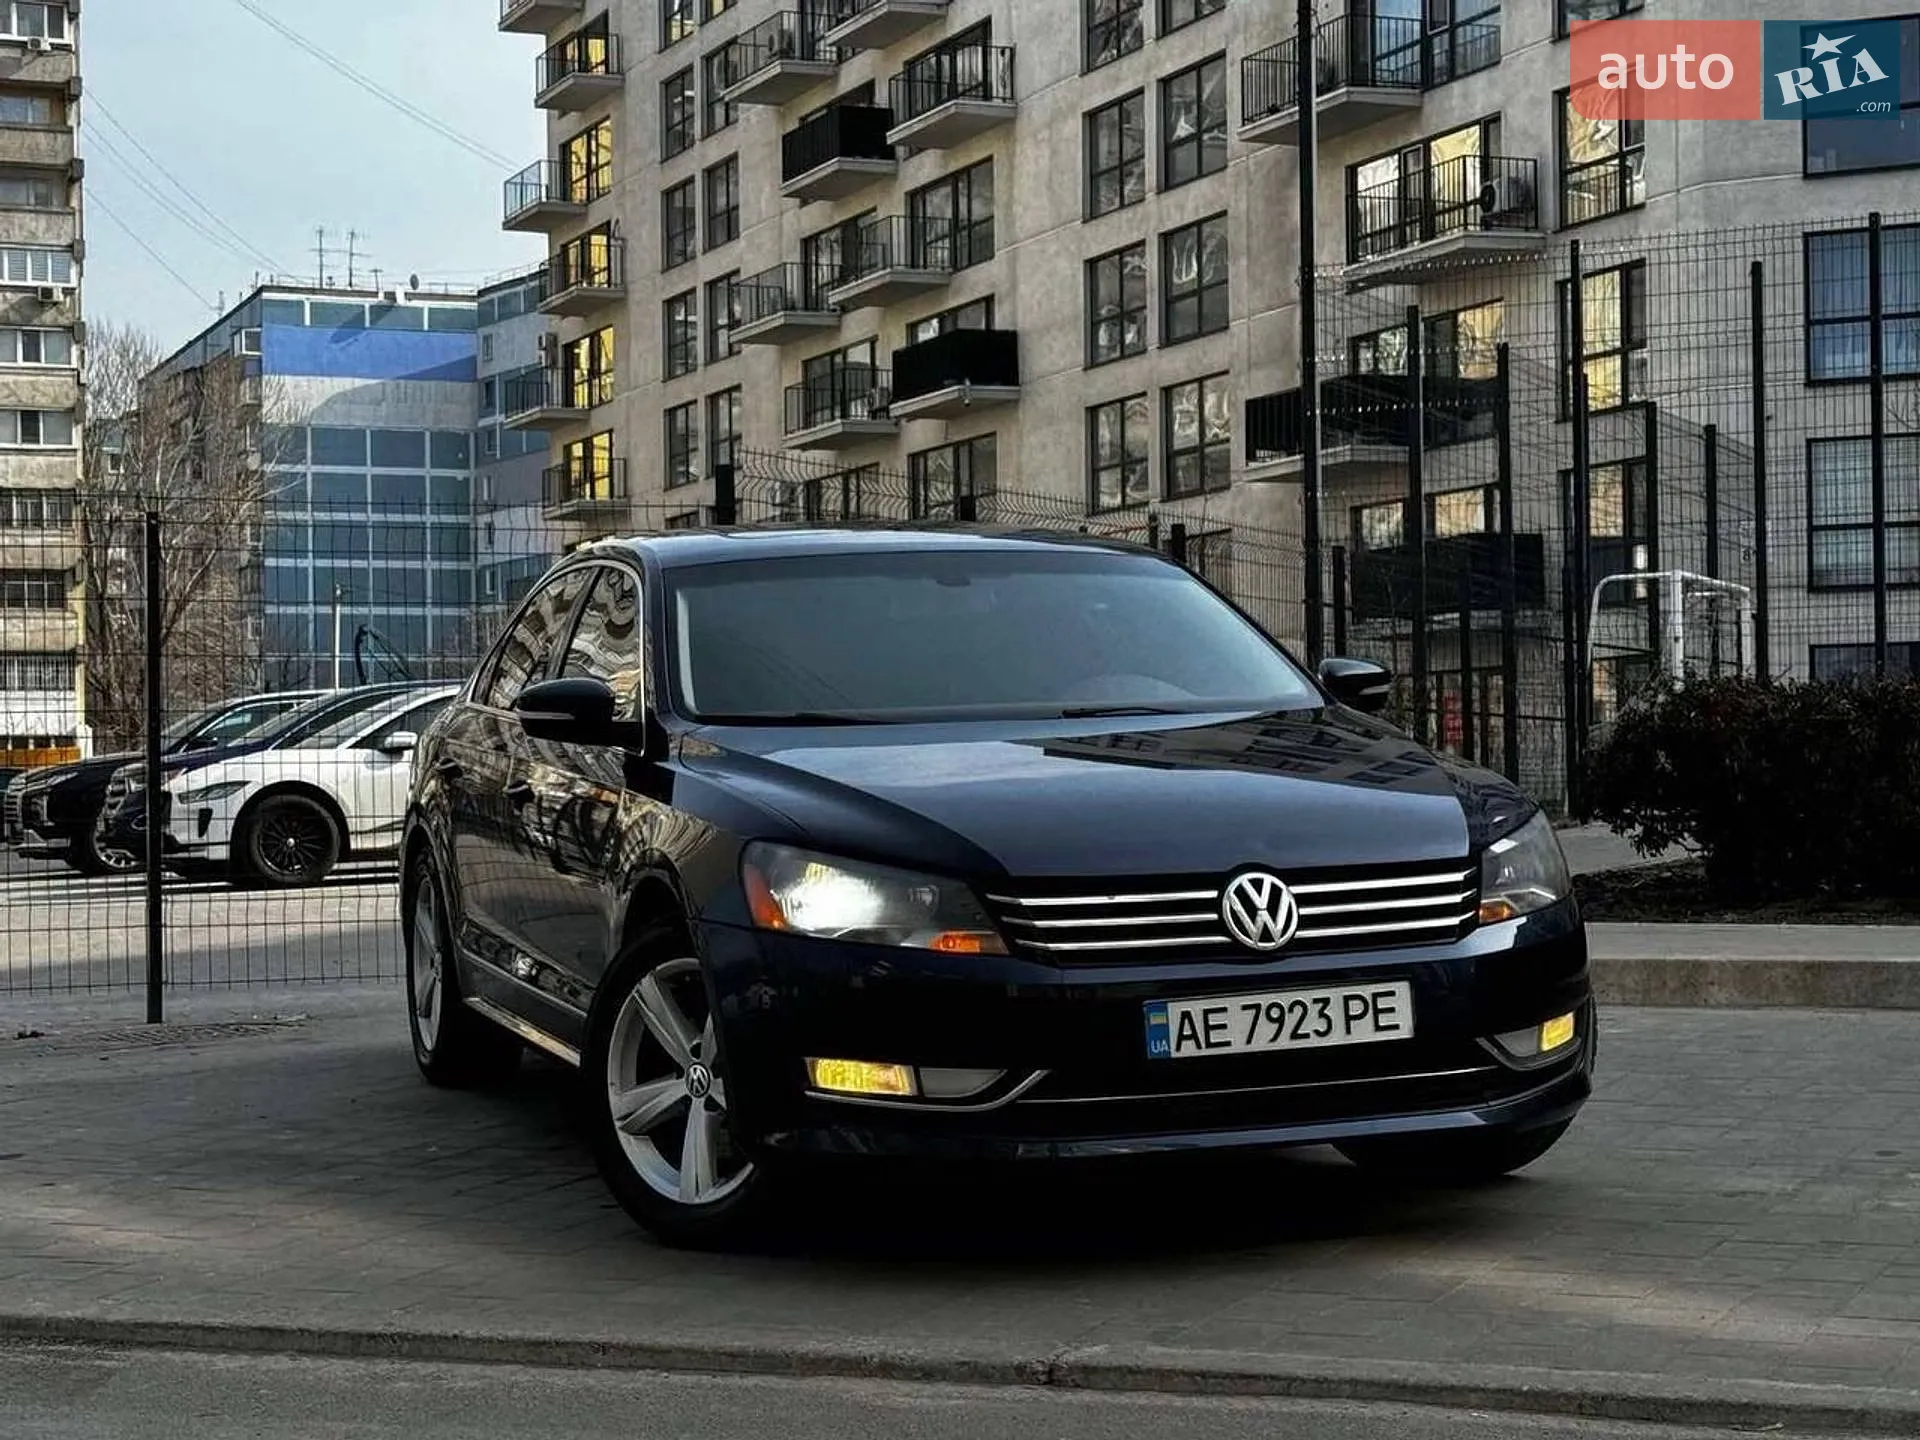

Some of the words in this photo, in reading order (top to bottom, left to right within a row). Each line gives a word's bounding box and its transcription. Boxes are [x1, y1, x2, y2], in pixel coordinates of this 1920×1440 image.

[1175, 1006, 1232, 1052] AE
[1241, 996, 1333, 1045] 7923
[1342, 990, 1400, 1035] PE
[1150, 1039, 1170, 1054] UA
